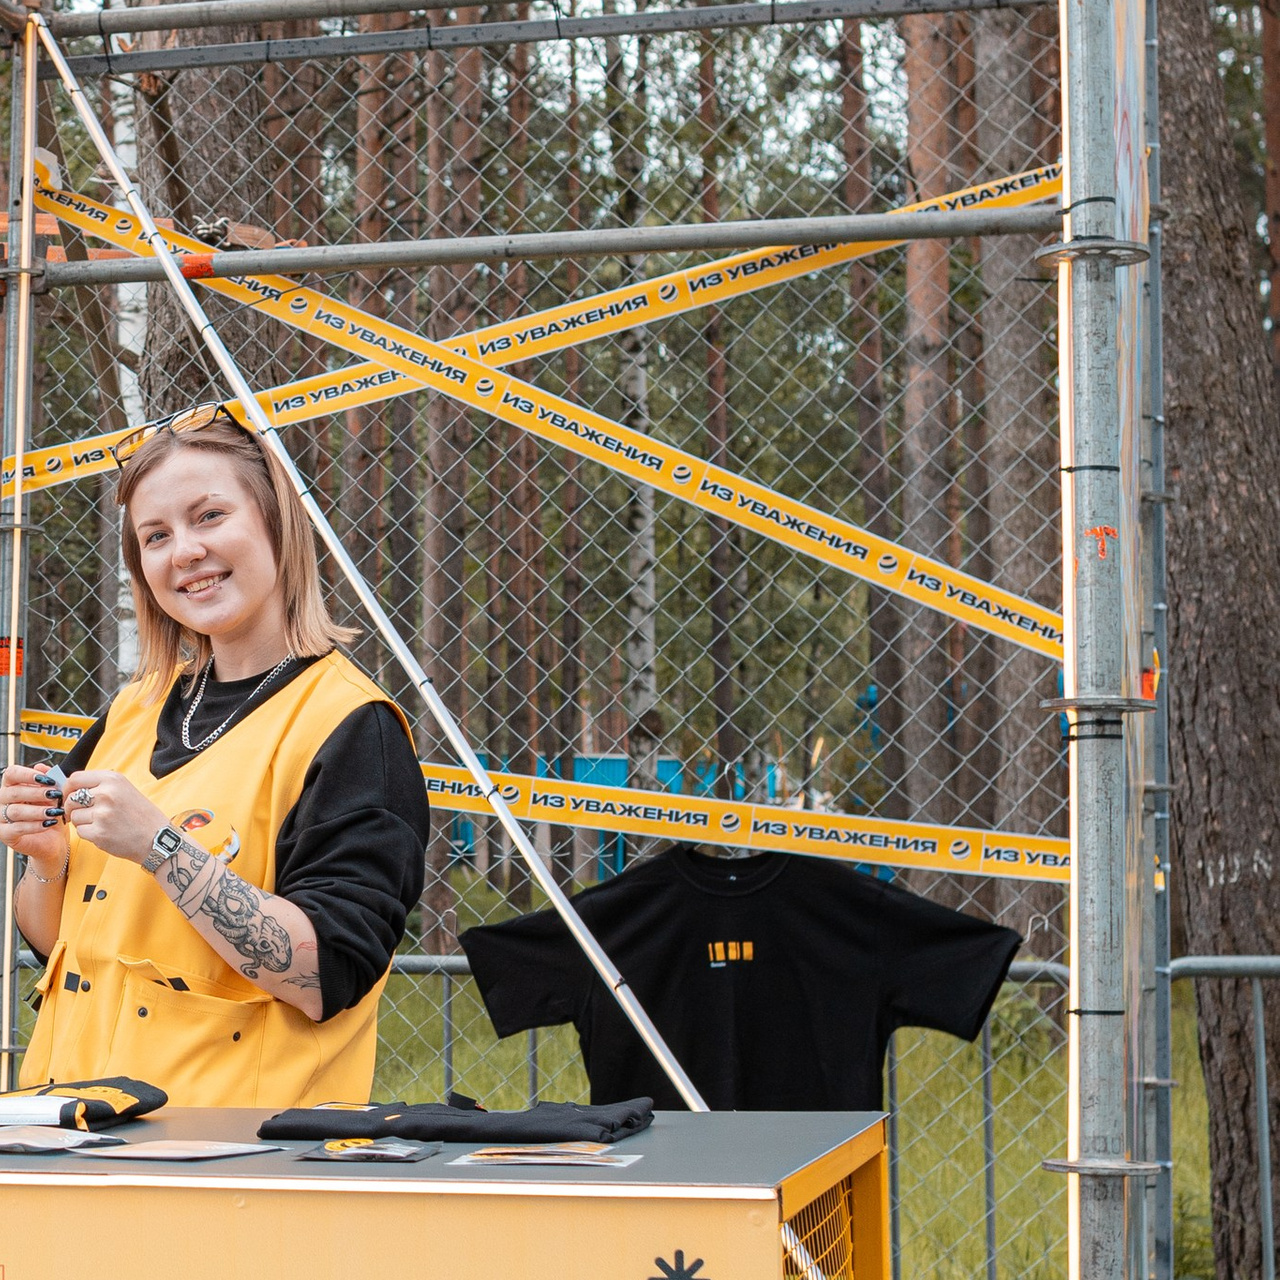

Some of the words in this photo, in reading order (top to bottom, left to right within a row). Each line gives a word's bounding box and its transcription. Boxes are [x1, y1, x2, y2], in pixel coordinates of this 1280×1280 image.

[689, 271, 722, 292] ИЗ
[479, 337, 512, 356] ИЗ
[515, 295, 648, 344] УВАЖЕНИЯ
[315, 309, 346, 330] ИЗ
[349, 323, 468, 384] УВАЖЕНИЯ
[274, 395, 306, 413] ИЗ
[502, 392, 535, 414] ИЗ
[538, 406, 664, 471] УВАЖЕНИЯ
[73, 449, 105, 466] ИЗ
[700, 479, 732, 502] ИЗ
[738, 495, 868, 560] УВАЖЕНИЯ
[908, 569, 941, 591] ИЗ
[532, 792, 565, 808] ИЗ
[571, 798, 709, 826] УВАЖЕНИЯ
[753, 820, 788, 836] ИЗ
[793, 826, 938, 854] УВАЖЕНИЯ
[984, 847, 1020, 862] ИЗ
